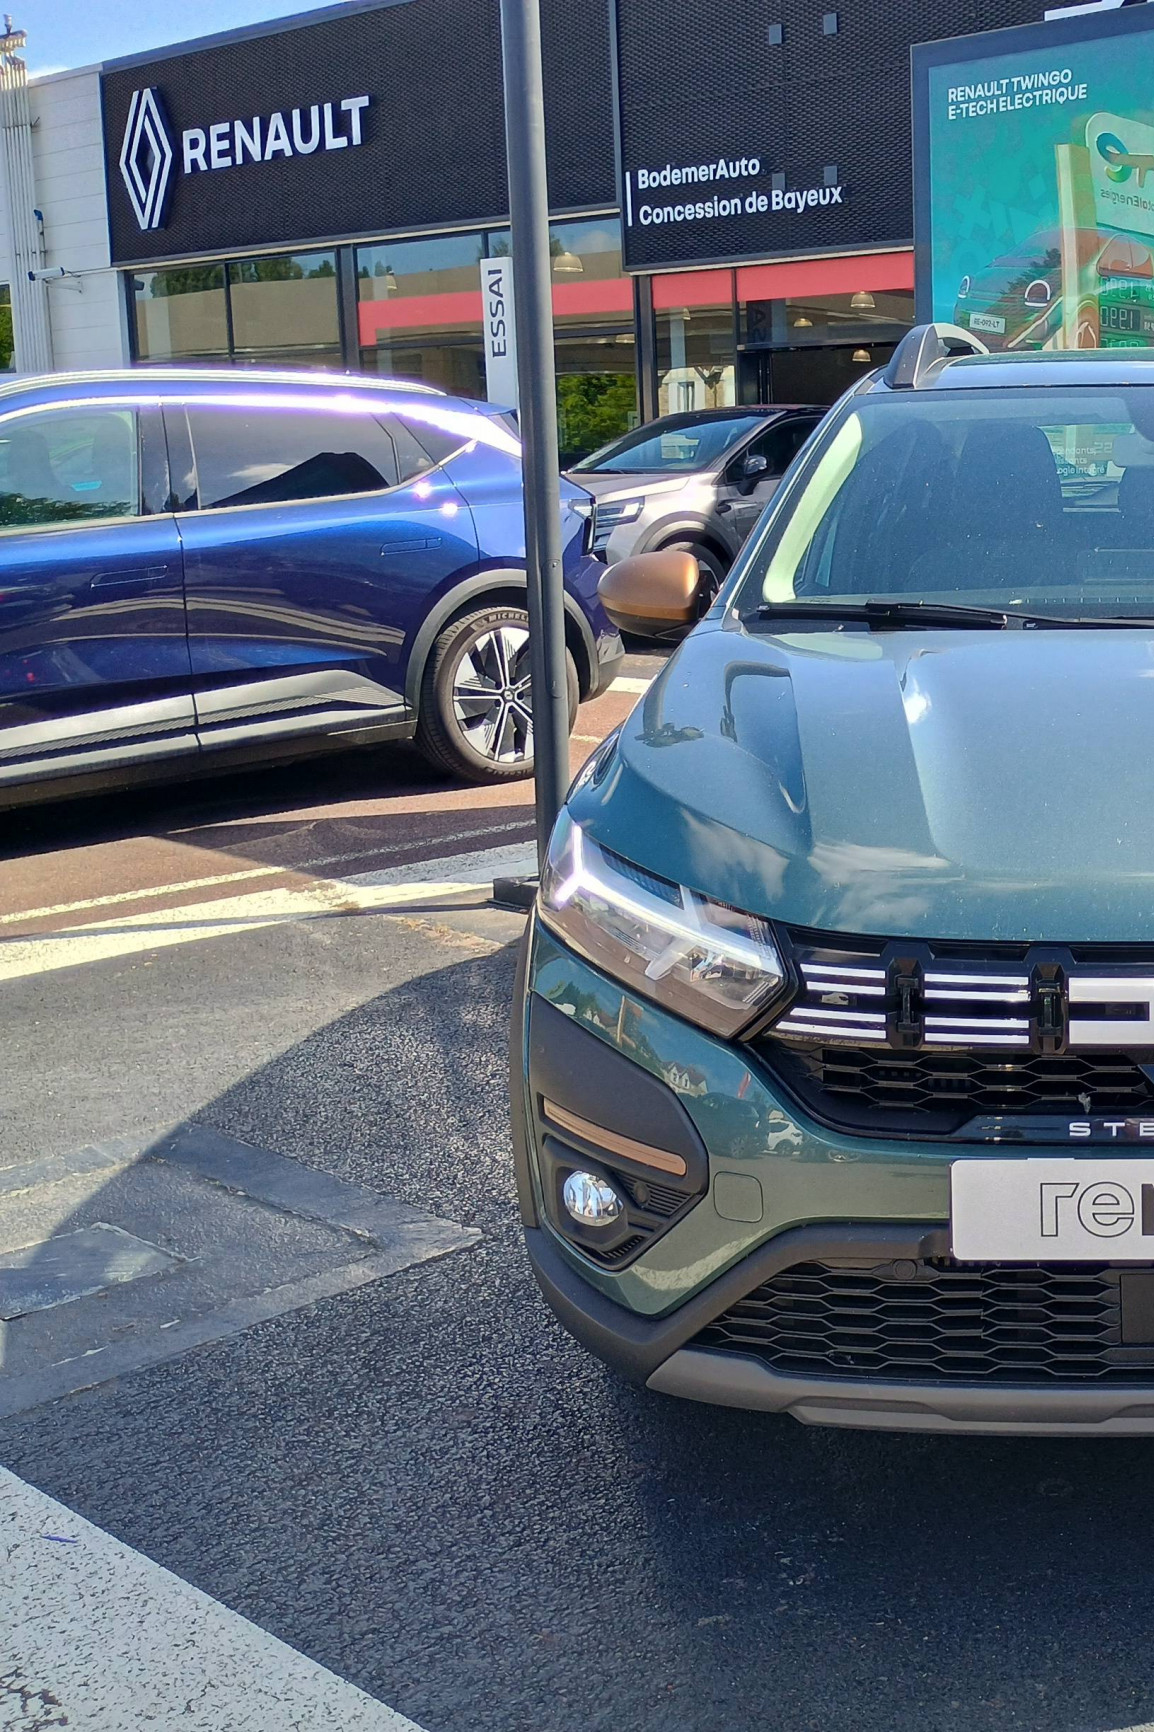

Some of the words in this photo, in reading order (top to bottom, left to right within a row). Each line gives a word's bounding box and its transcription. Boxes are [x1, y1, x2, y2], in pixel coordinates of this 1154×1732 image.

[948, 79, 1011, 103] RENAULT
[1011, 68, 1073, 91] TWINGO
[948, 101, 997, 120] E-TECH
[999, 83, 1088, 112] ELECTRIQUE
[182, 95, 370, 174] RENAULT
[637, 157, 761, 189] BodemerAuto
[639, 196, 742, 226] Concession
[745, 191, 769, 213] de
[771, 186, 843, 213] Bayeux
[487, 268, 507, 358] ESSAI
[488, 612, 528, 622] MICHEL
